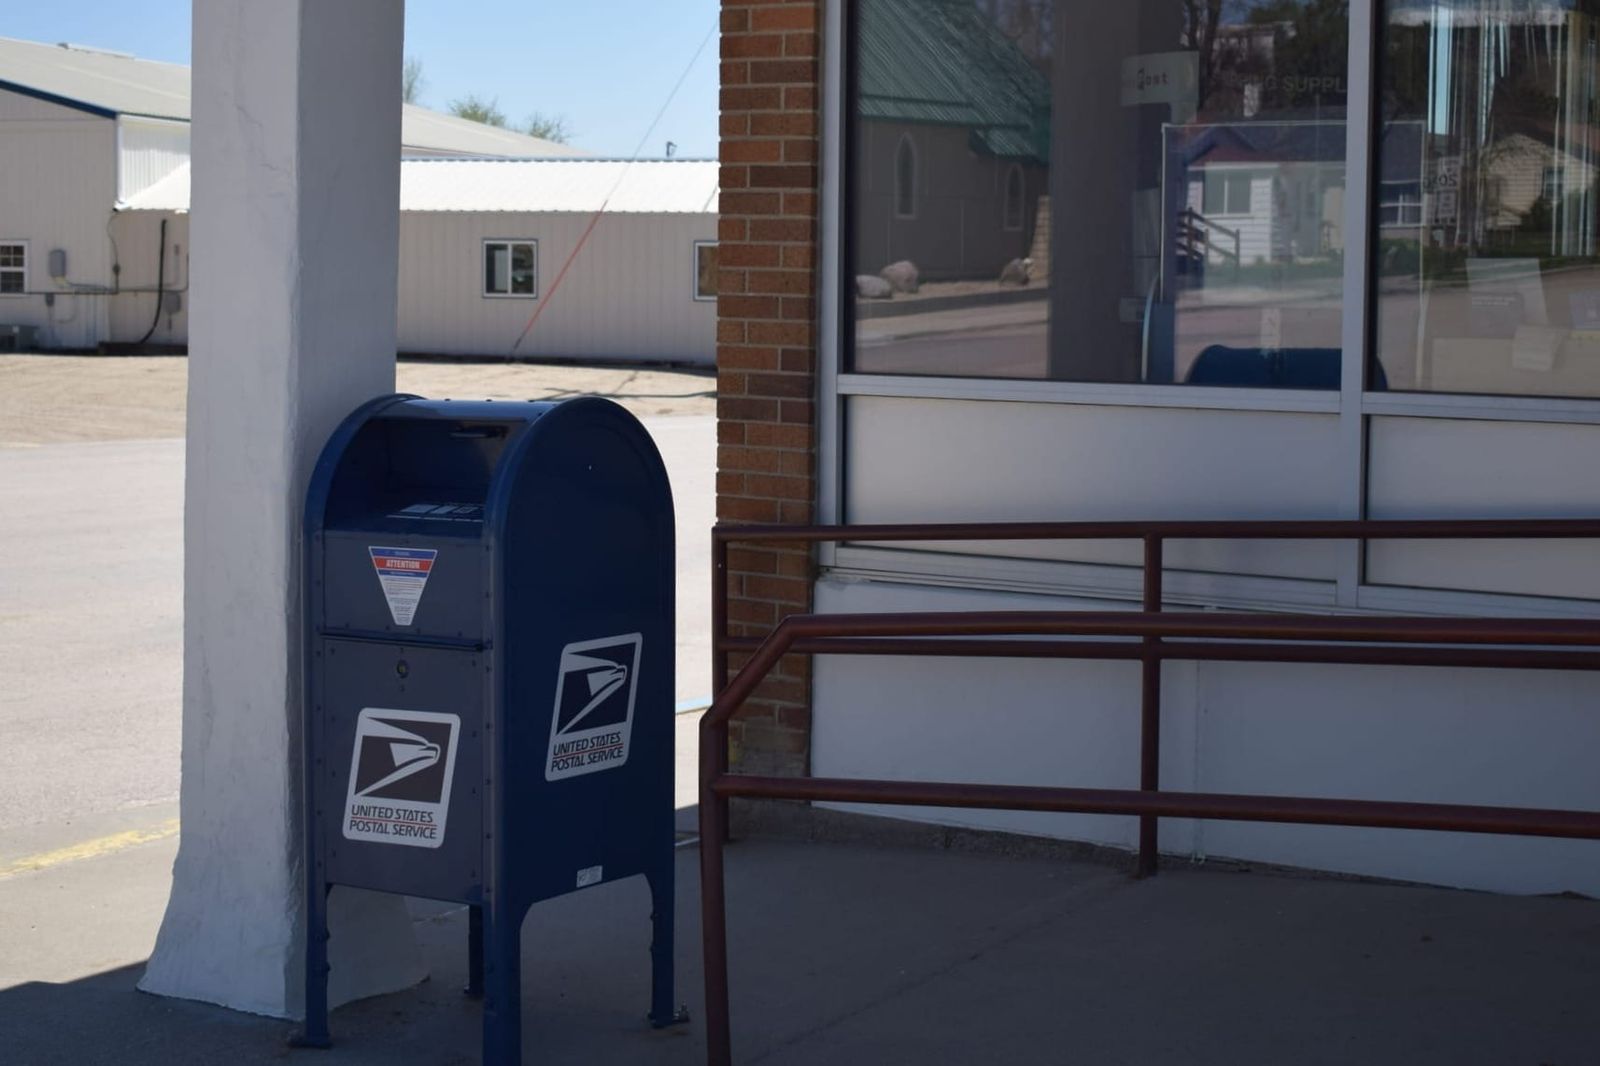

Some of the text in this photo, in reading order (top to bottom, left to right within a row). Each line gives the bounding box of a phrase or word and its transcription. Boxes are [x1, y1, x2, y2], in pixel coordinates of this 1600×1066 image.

[386, 559, 420, 569] ATTENTION
[553, 731, 621, 756] UNITED STATES
[551, 747, 624, 772] POSTAL SERVICE
[352, 804, 435, 823] UNITED STATES
[349, 820, 437, 840] POSTAL SERVICE
